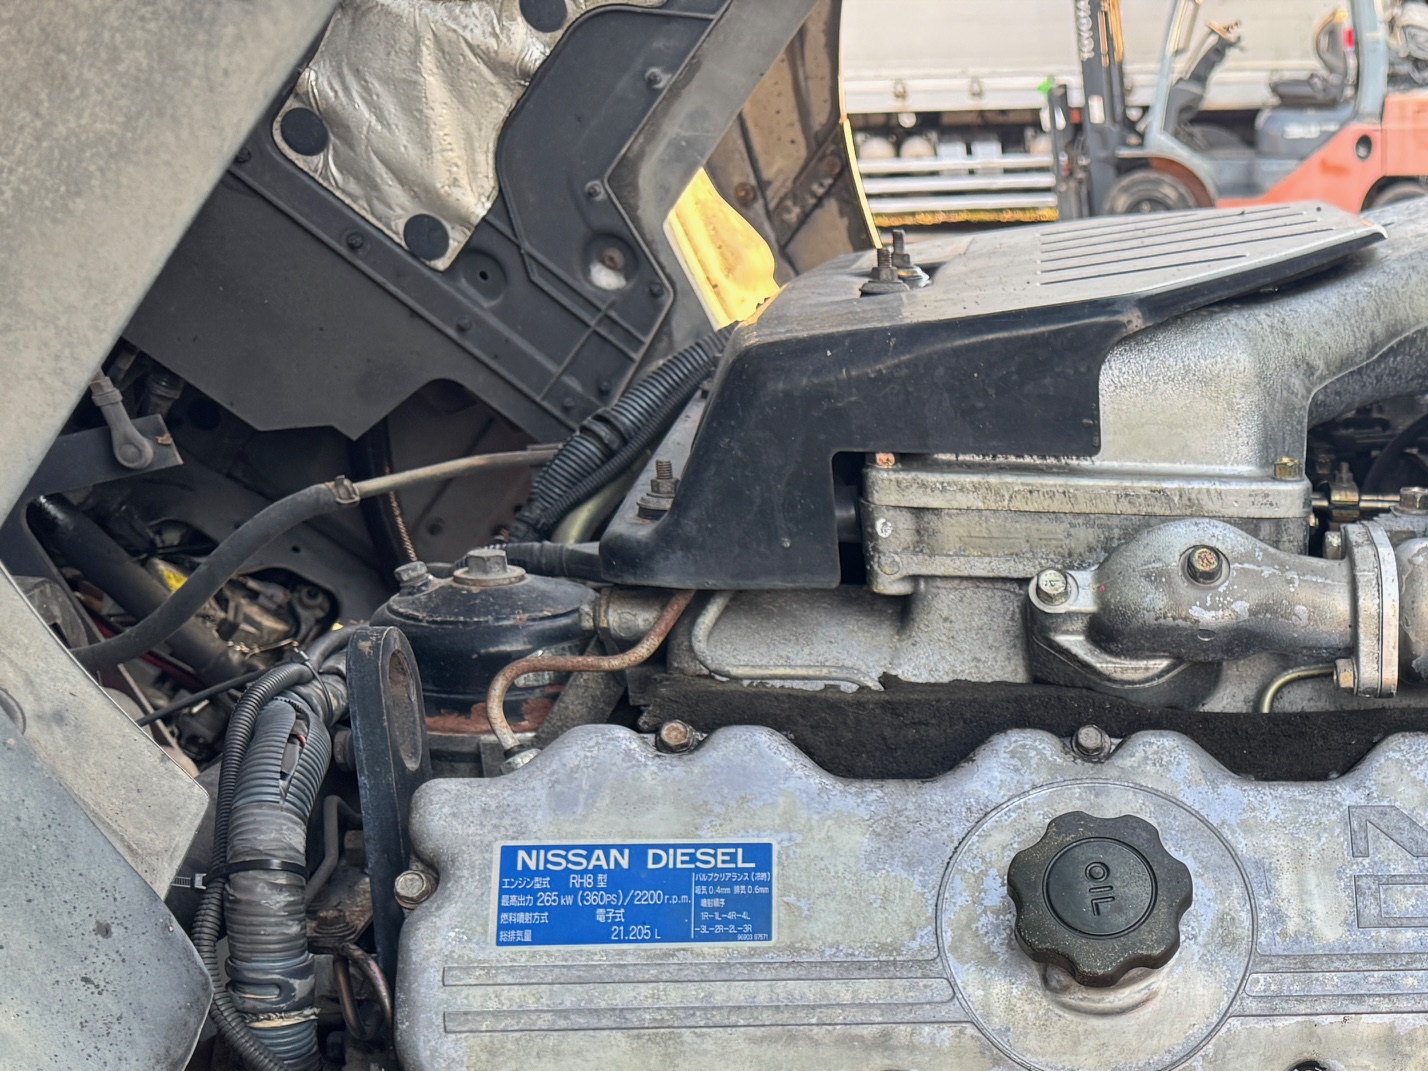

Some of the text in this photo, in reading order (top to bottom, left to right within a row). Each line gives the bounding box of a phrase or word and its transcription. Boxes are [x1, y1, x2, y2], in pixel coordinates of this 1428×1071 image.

[517, 848, 756, 871] NISSAN DIESEL
[502, 877, 551, 889] エンジン型式
[570, 874, 594, 889] RH8
[1084, 861, 1116, 917] OIL
[501, 894, 534, 907] 最高出力
[537, 892, 559, 906] 265
[561, 895, 574, 906] kW
[500, 908, 625, 924] 燃料噴射方式 電子式
[499, 925, 661, 942] 総排気量 21.205 L
